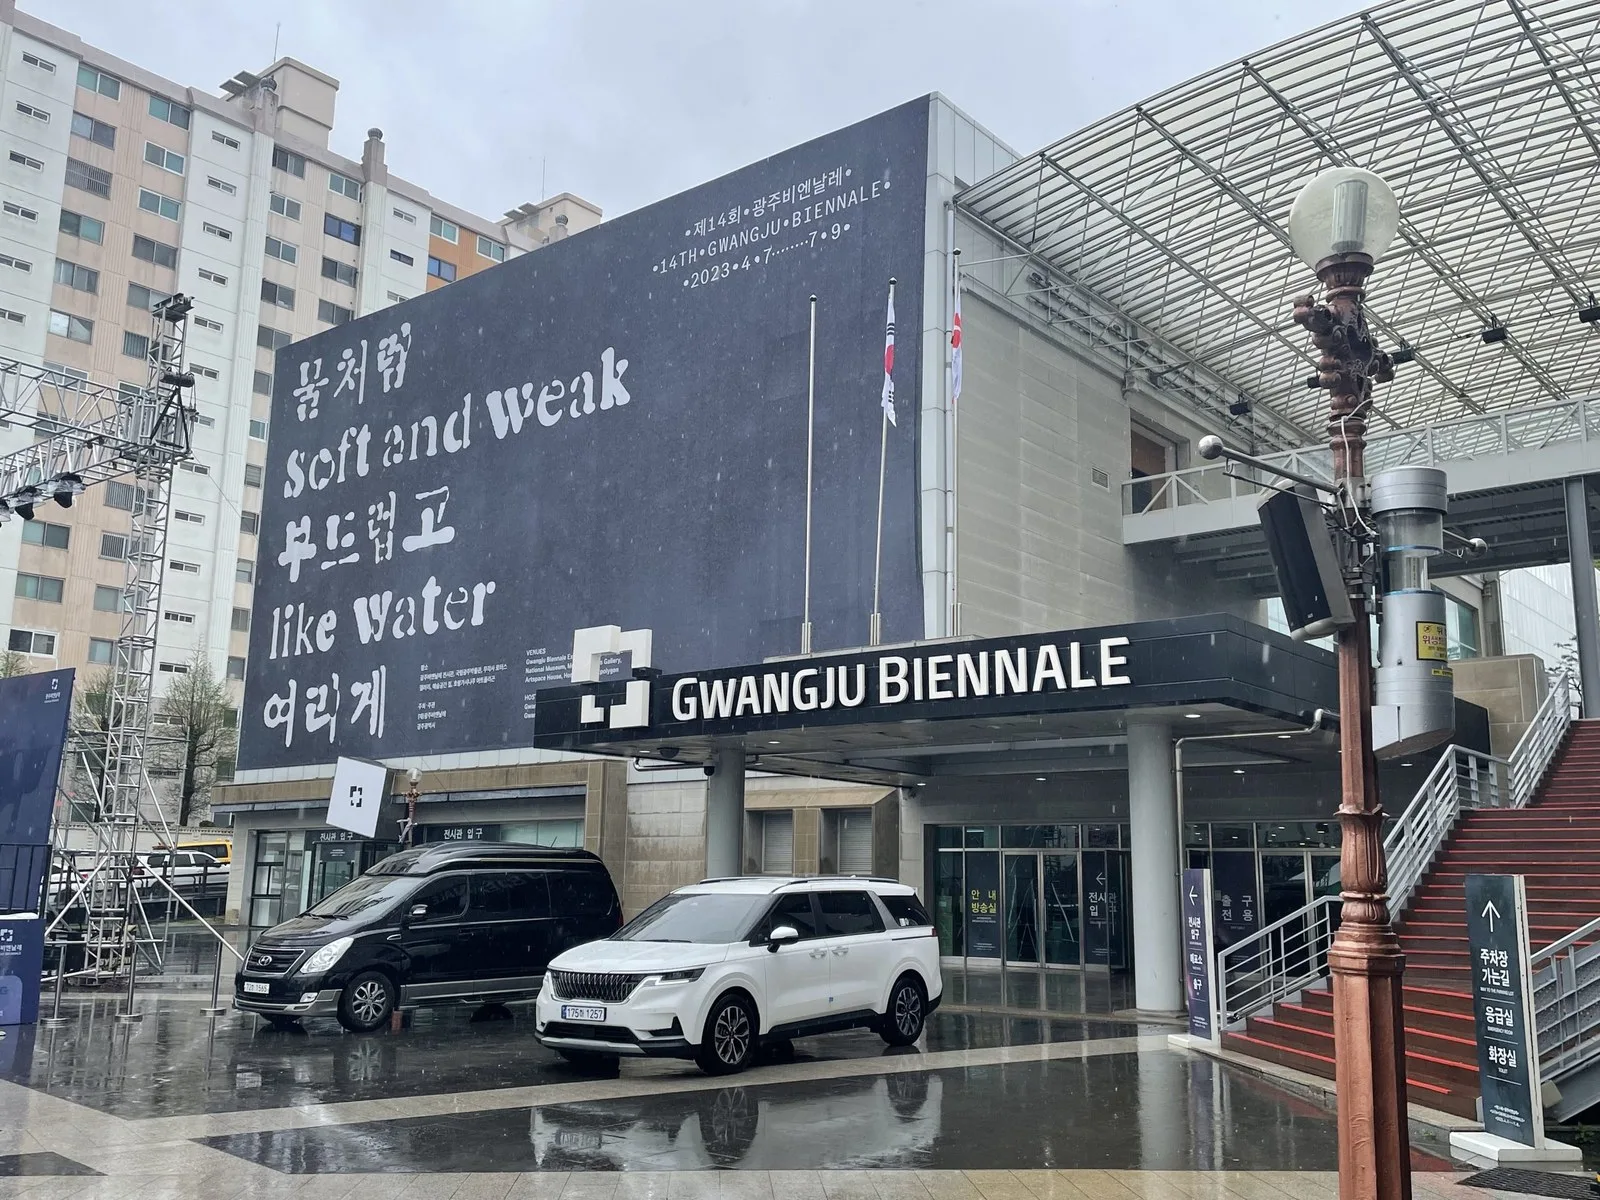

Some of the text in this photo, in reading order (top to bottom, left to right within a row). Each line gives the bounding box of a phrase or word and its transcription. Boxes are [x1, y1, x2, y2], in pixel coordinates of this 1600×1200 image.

[292, 322, 412, 422] 물처럼
[383, 392, 471, 467] and
[278, 485, 455, 583] 부드럽고
[269, 575, 496, 660] like water
[671, 636, 1132, 722] GWANGJU BIENNALE
[263, 664, 386, 748] 여리게
[443, 828, 463, 840] 전시관
[971, 902, 997, 914] 방송실
[1480, 948, 1509, 968] 주차장
[1481, 967, 1510, 987] 가는길
[1485, 1006, 1514, 1027] 응급실
[1488, 1045, 1517, 1068] 화장실
